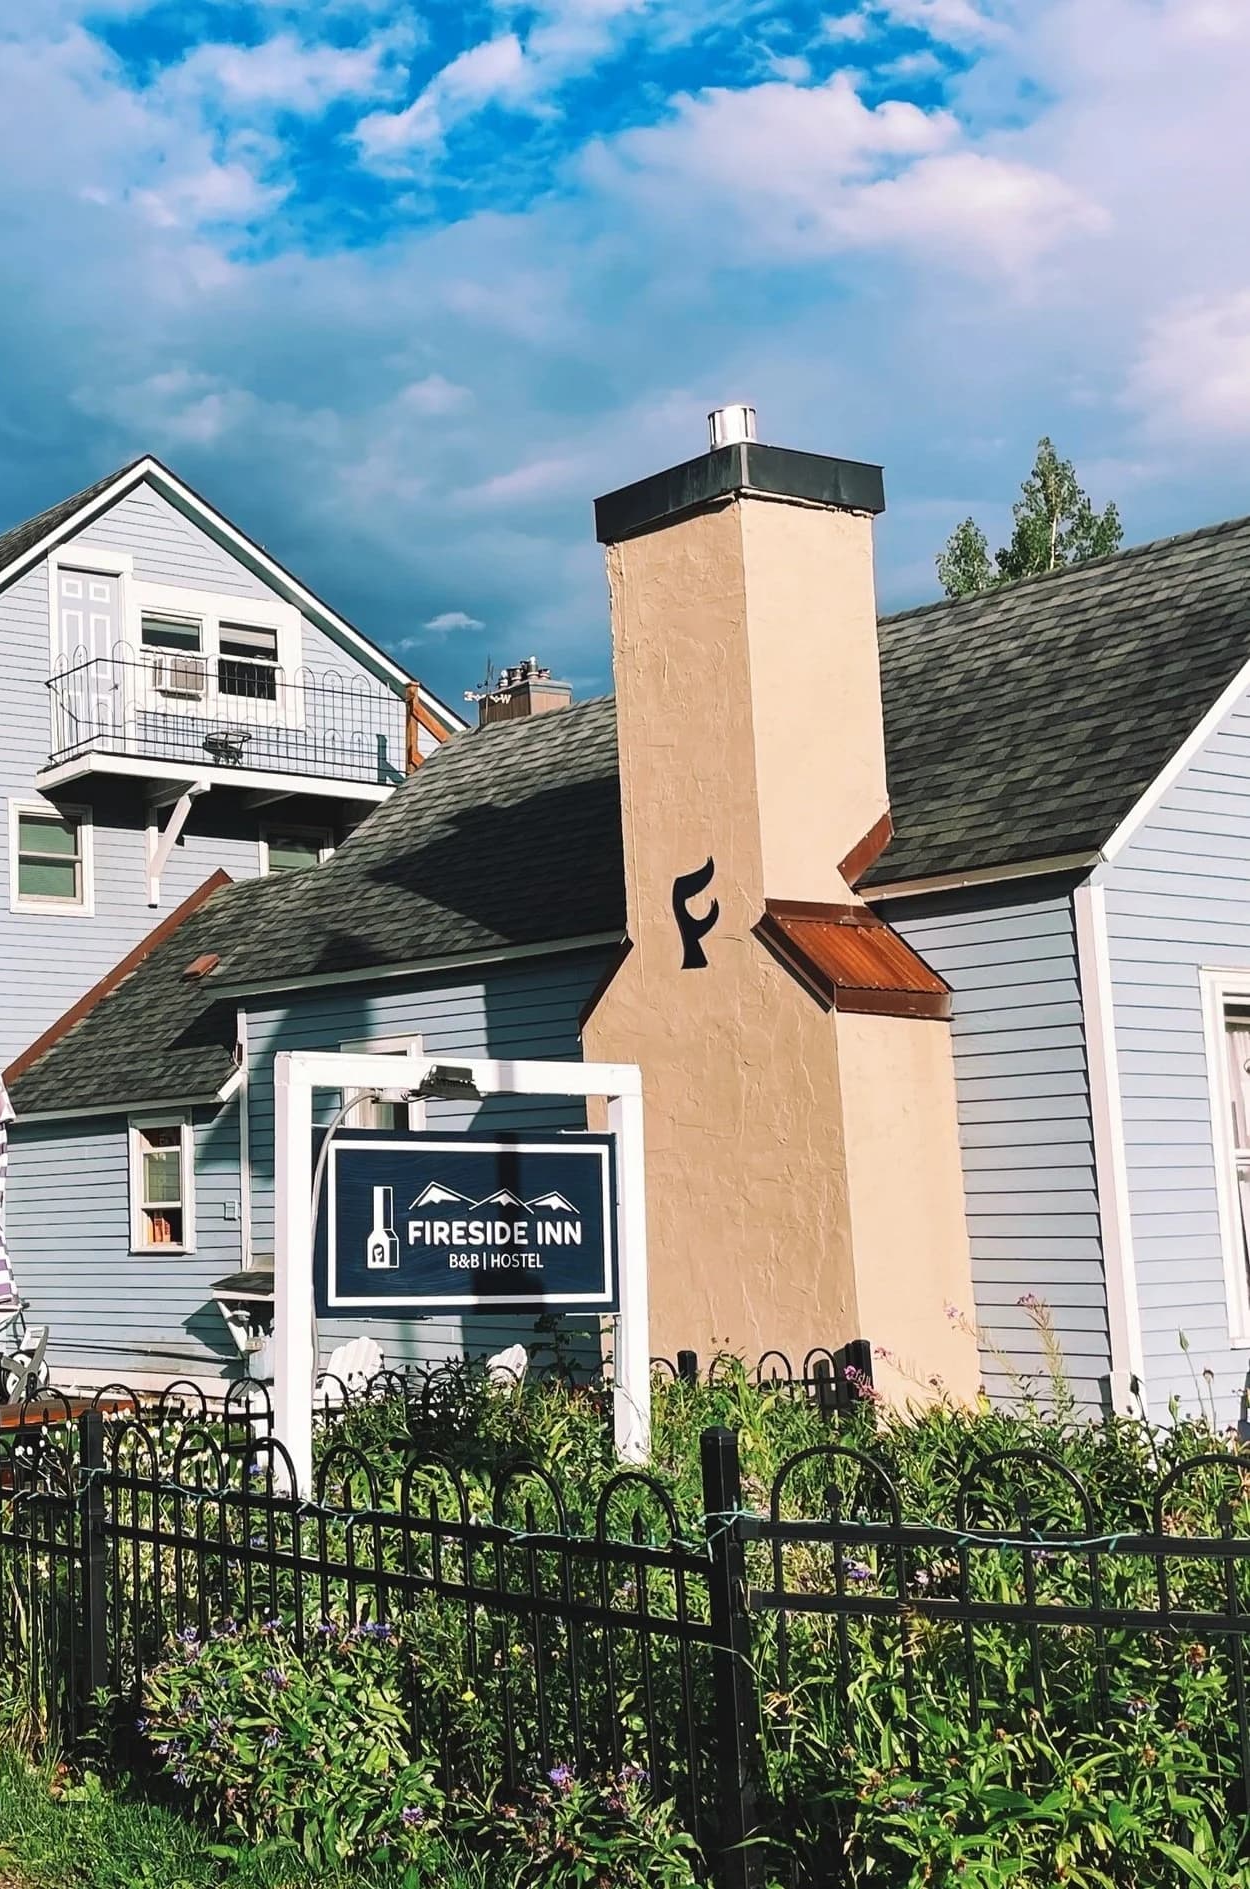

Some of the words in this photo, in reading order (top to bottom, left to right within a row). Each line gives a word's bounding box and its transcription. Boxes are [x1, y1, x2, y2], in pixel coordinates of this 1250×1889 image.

[408, 1220, 529, 1246] FIRESIDE
[536, 1220, 582, 1246] INN
[449, 1252, 480, 1269] B&B
[490, 1252, 544, 1269] HOSTEL
